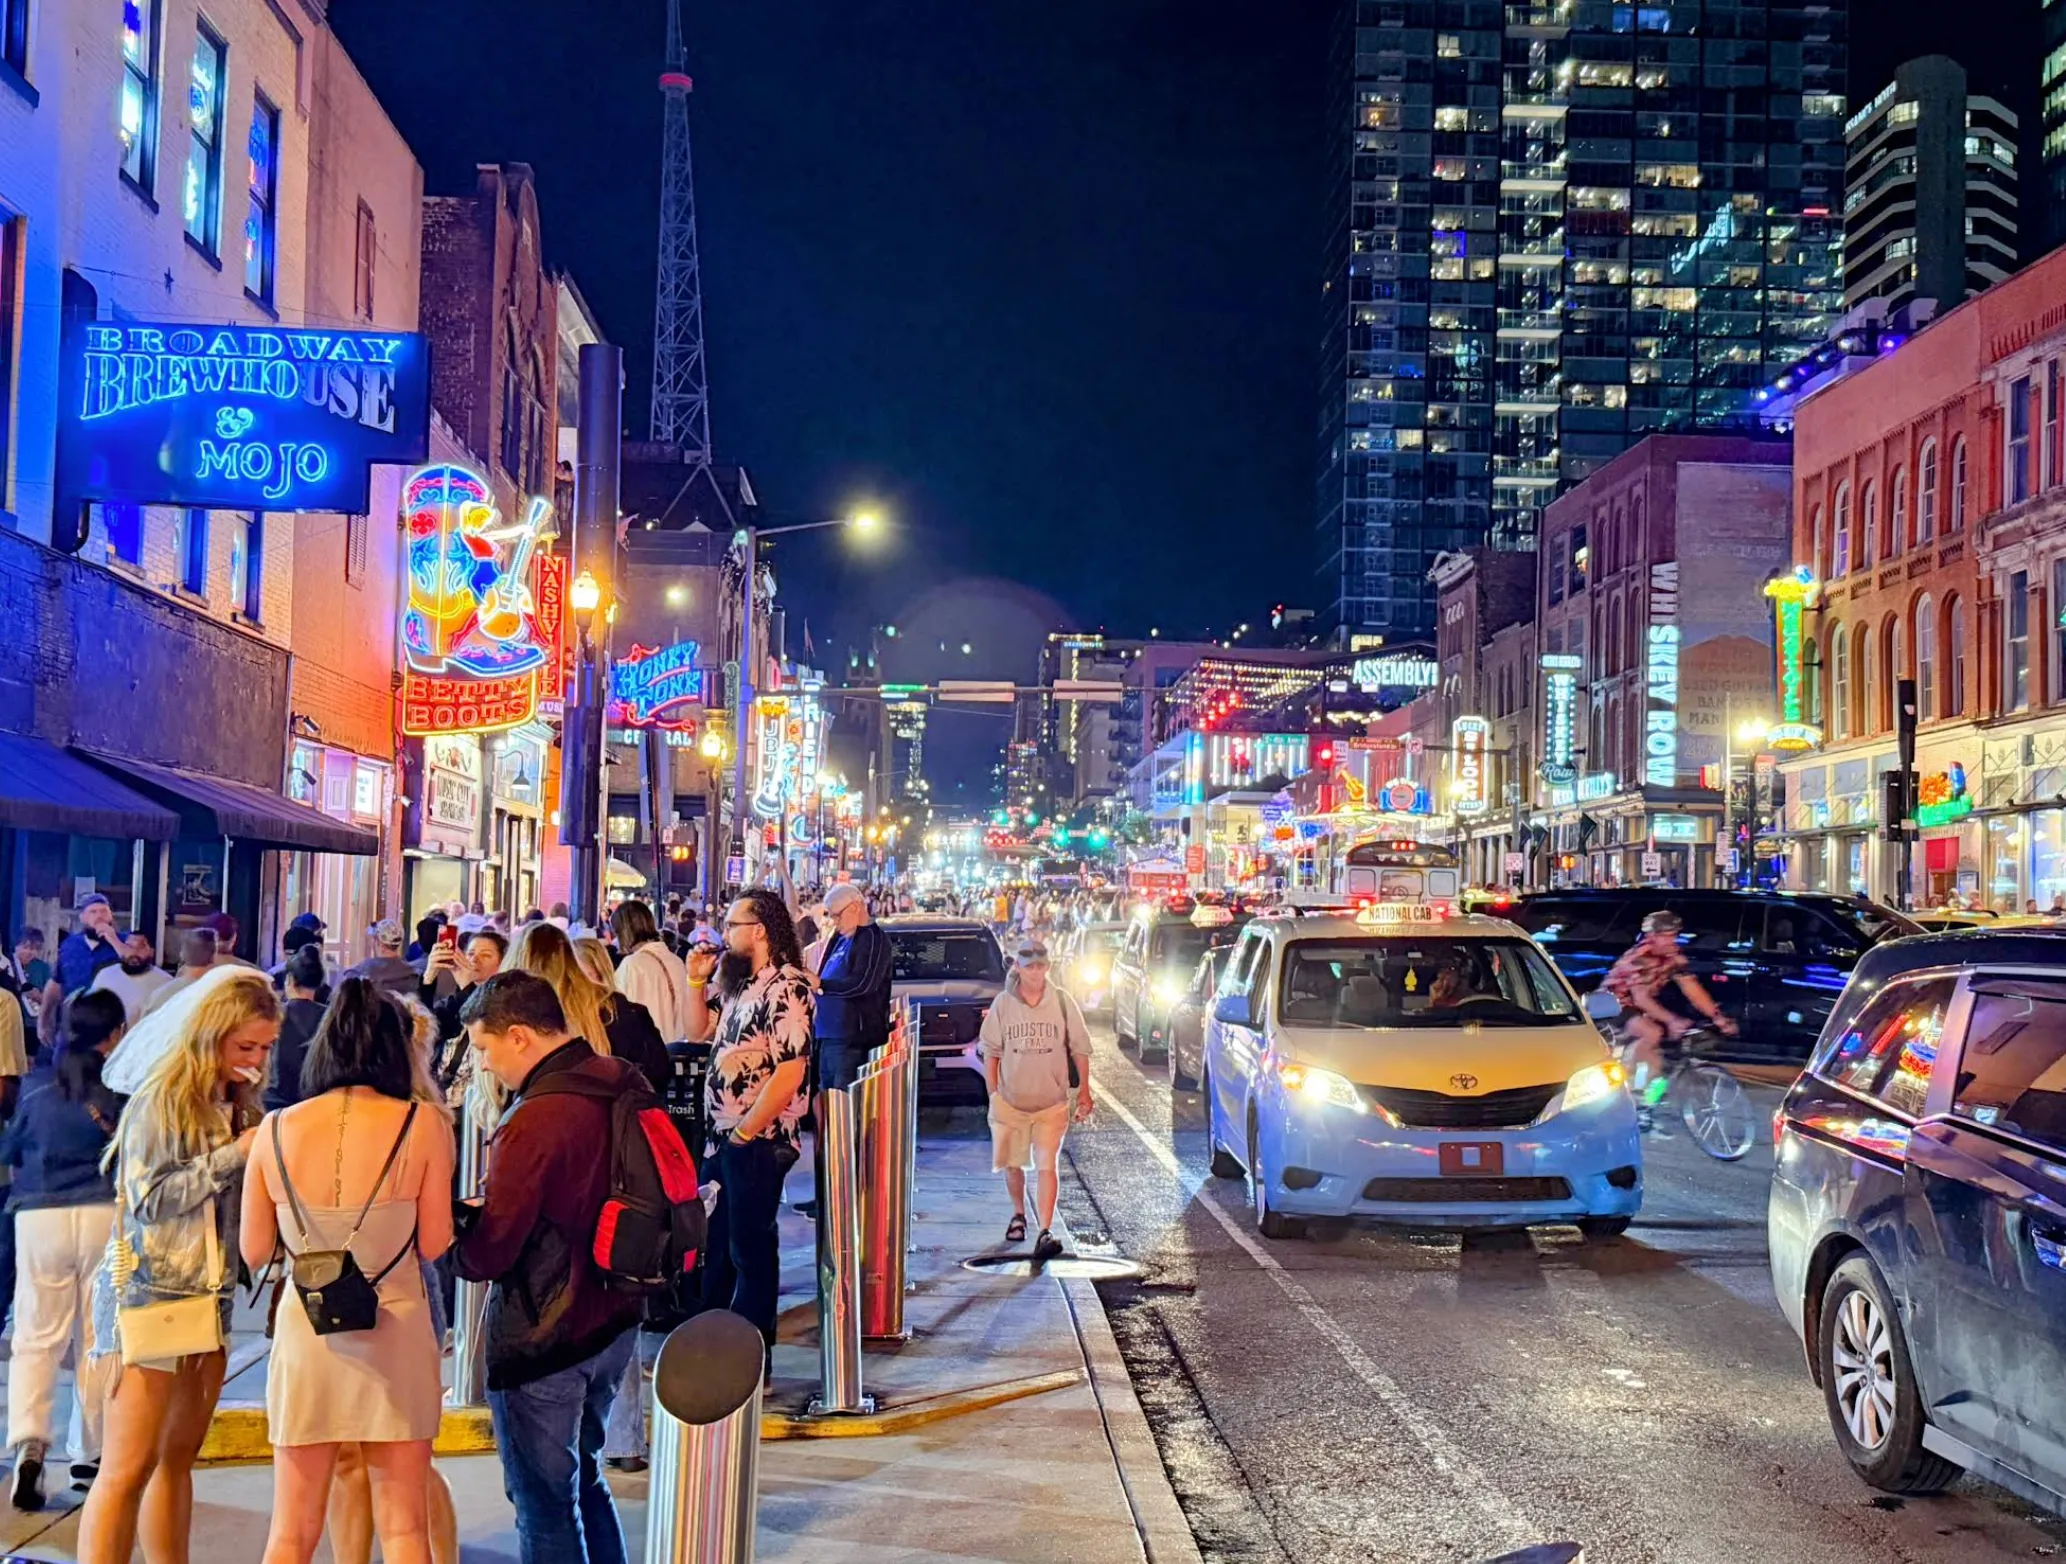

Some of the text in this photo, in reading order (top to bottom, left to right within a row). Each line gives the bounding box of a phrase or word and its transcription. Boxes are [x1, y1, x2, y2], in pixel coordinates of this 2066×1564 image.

[87, 327, 400, 362] BROADWAY
[79, 352, 396, 434] BREWHOUSE
[216, 406, 253, 438] &
[196, 440, 328, 499] MOJO
[541, 556, 561, 697] NASHVILE
[1647, 562, 1680, 704] WHISKEY
[616, 640, 698, 698] HONKY
[1352, 659, 1432, 686] ASSEMBLY
[409, 677, 529, 702] BETTY
[633, 671, 701, 720] TONK
[409, 700, 528, 728] BOOTS
[623, 729, 693, 746] CERAL
[1646, 711, 1677, 787] ROW
[1369, 906, 1432, 920] NATIONAL CAB
[1005, 1022, 1059, 1041] HOUSTON
[668, 1104, 694, 1114] Trash
